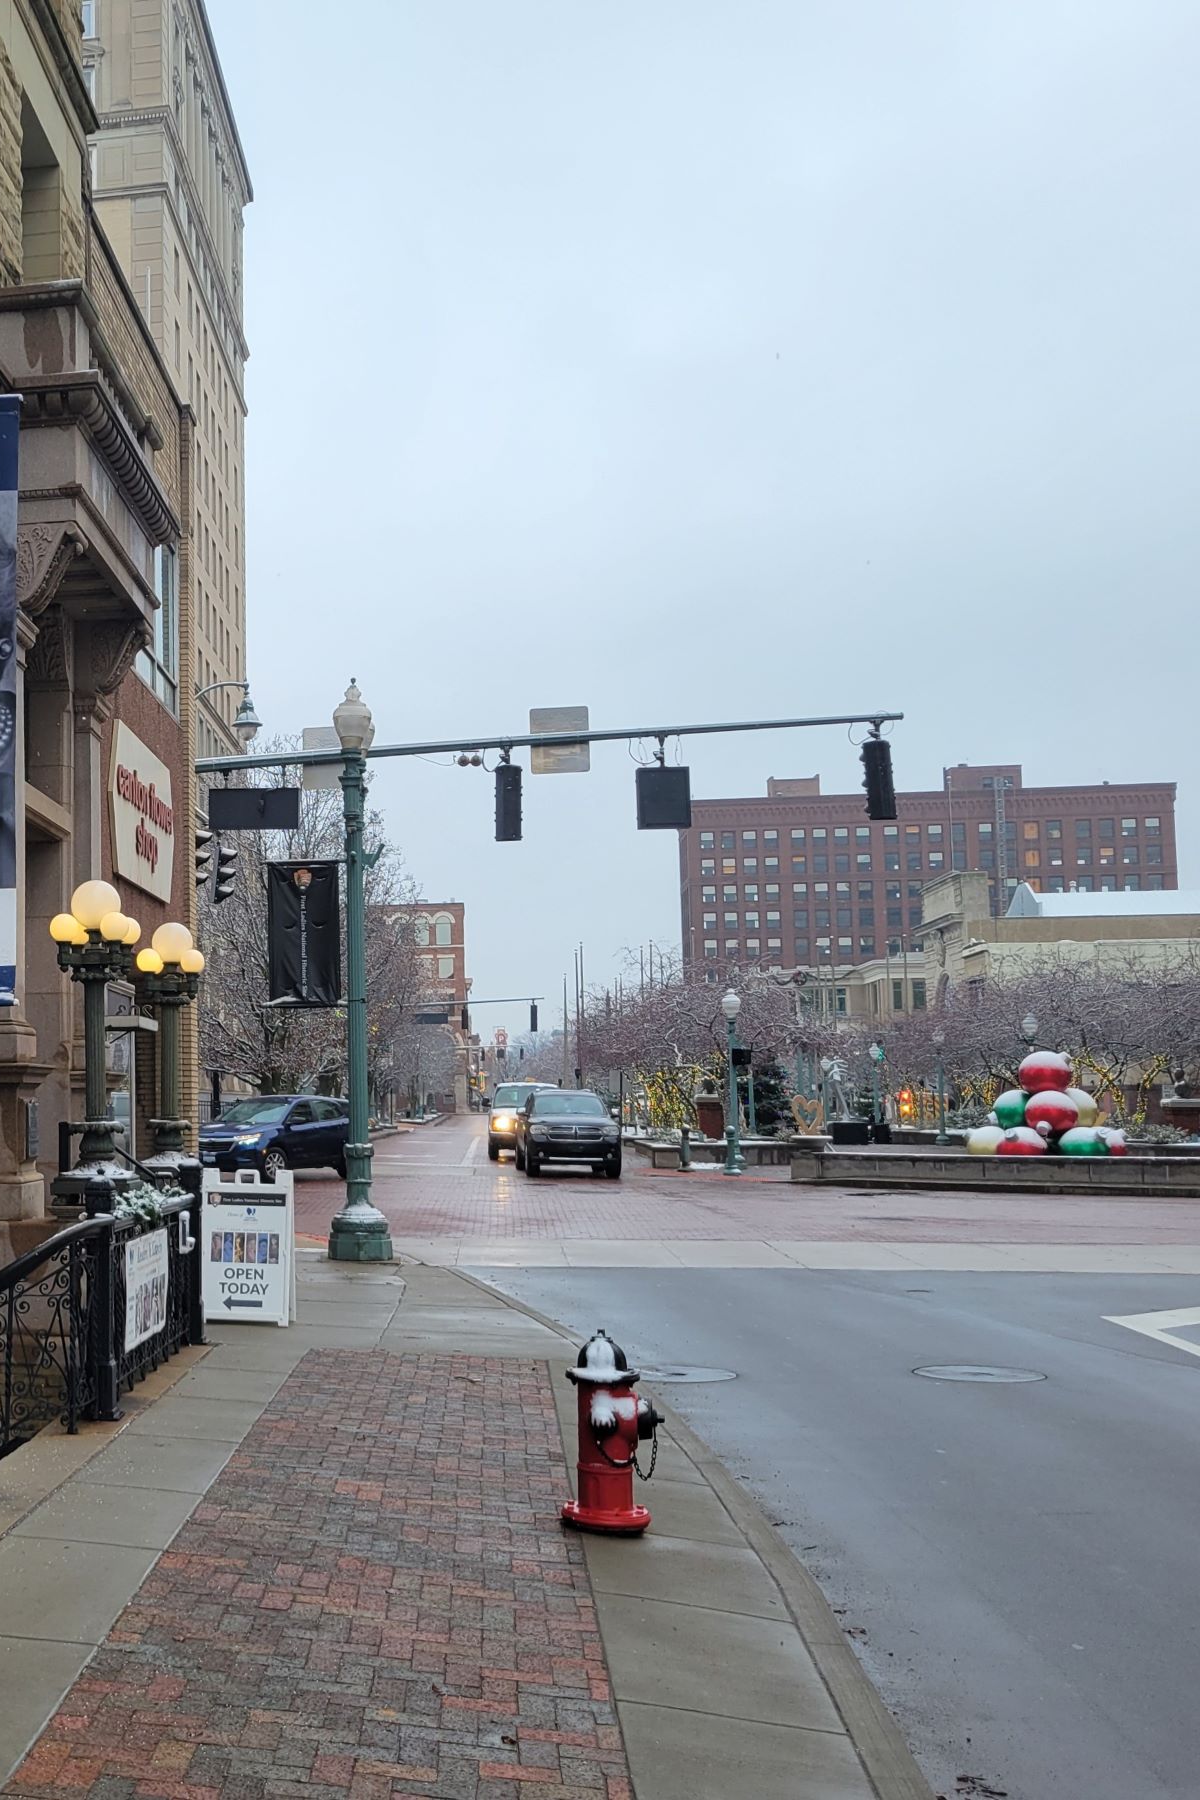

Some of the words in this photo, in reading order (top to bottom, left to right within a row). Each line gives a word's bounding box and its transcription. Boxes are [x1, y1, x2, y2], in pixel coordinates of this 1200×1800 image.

[116, 763, 149, 817] canton
[149, 782, 174, 837] flower
[135, 816, 159, 875] shop
[218, 1281, 270, 1296] TODAY
[223, 1267, 264, 1281] OPEN
